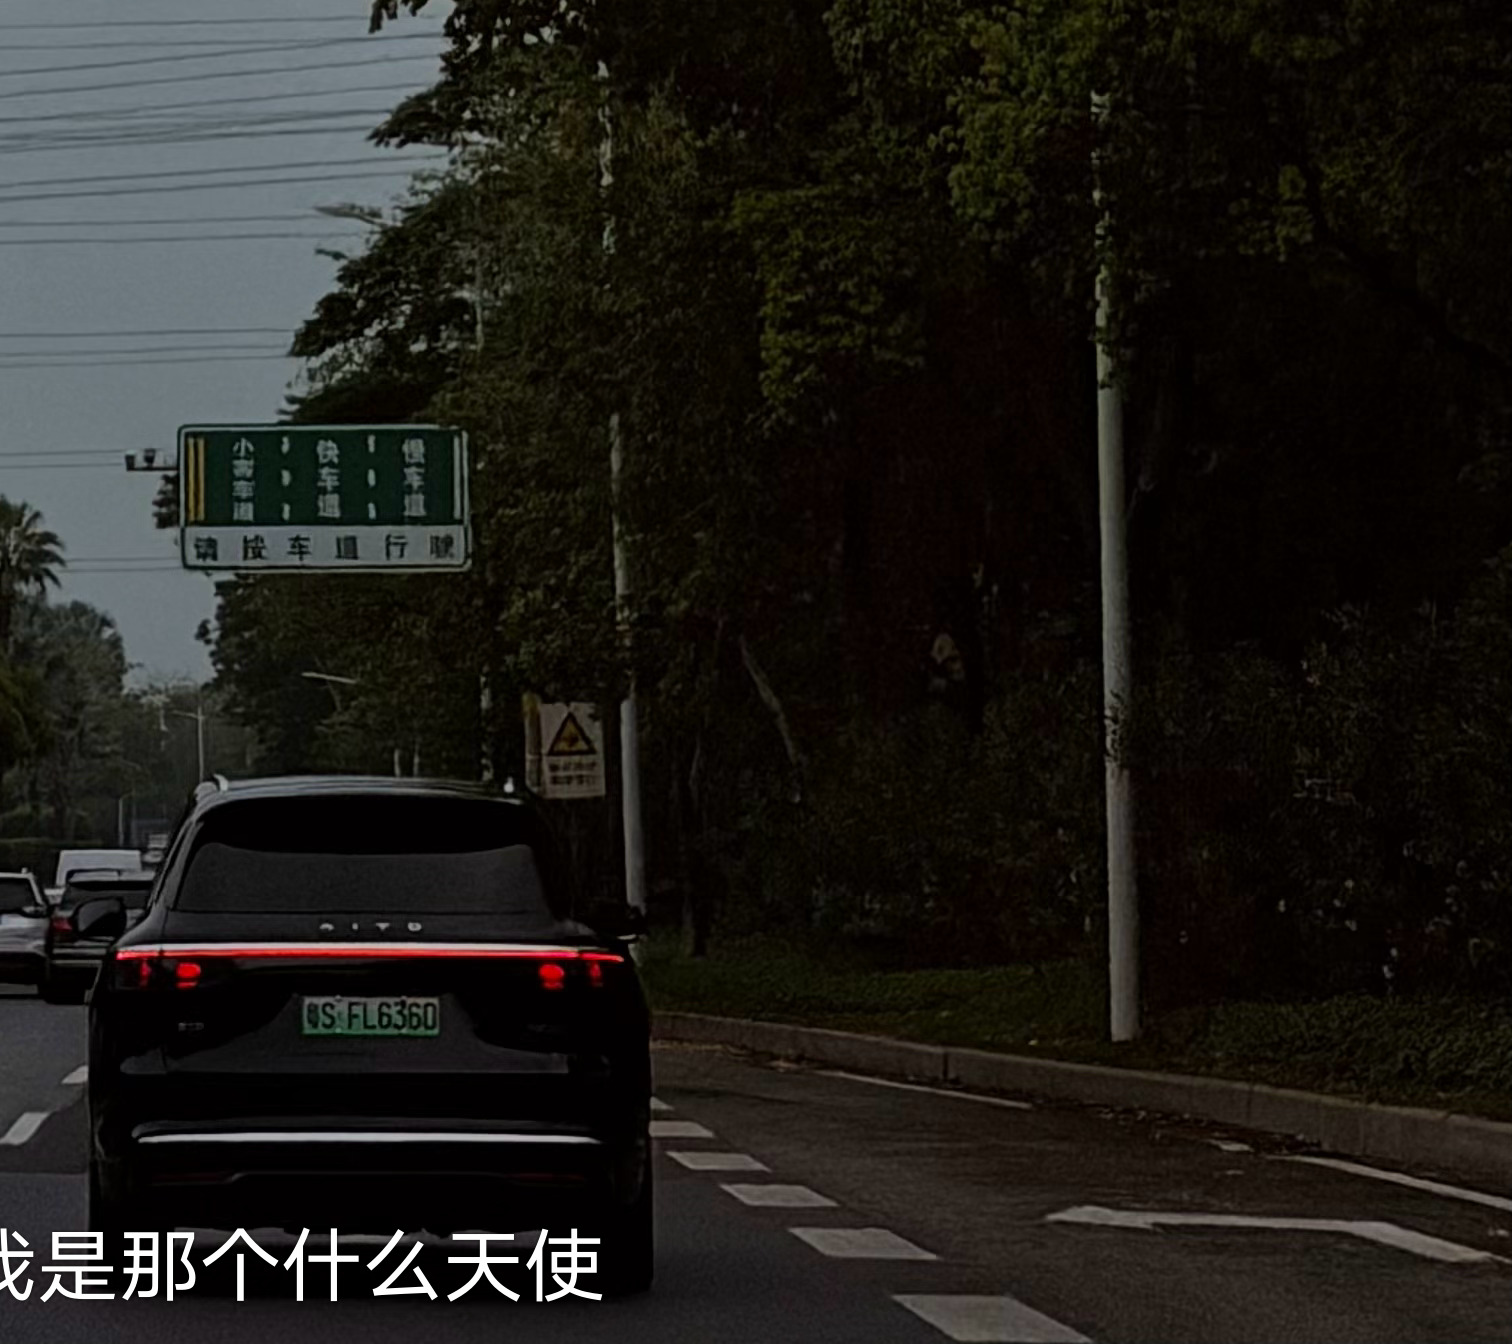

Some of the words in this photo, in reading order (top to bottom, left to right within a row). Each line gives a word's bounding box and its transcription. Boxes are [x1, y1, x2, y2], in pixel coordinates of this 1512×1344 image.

[316, 438, 342, 519] 快车道
[193, 534, 456, 562] 请按车道行驶
